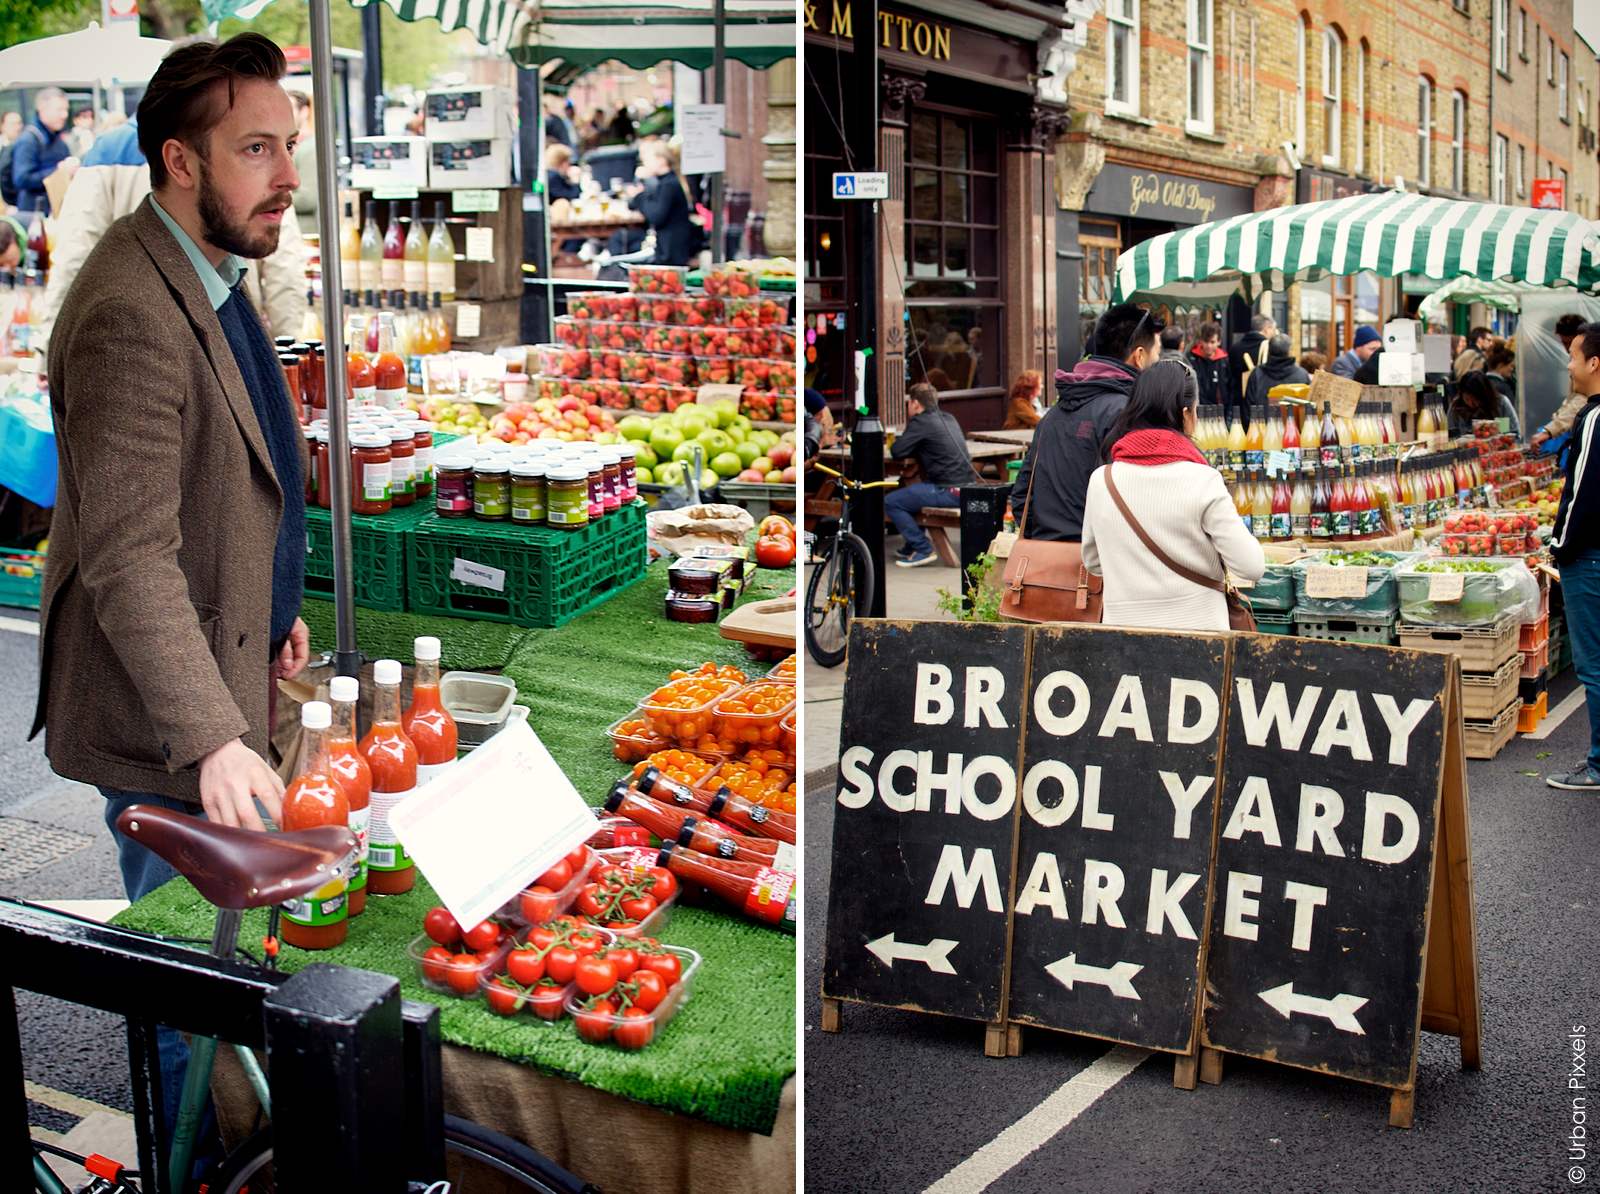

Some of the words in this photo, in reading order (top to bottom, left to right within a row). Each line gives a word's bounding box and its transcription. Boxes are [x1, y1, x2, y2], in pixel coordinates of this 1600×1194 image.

[830, 0, 951, 60] MTTON
[1129, 173, 1159, 216] Good
[1162, 181, 1186, 208] Old
[914, 663, 1434, 766] BROADWAY
[837, 745, 1114, 832] SCHOOL
[1159, 769, 1420, 865] YARD
[924, 844, 1328, 952] MARKET
